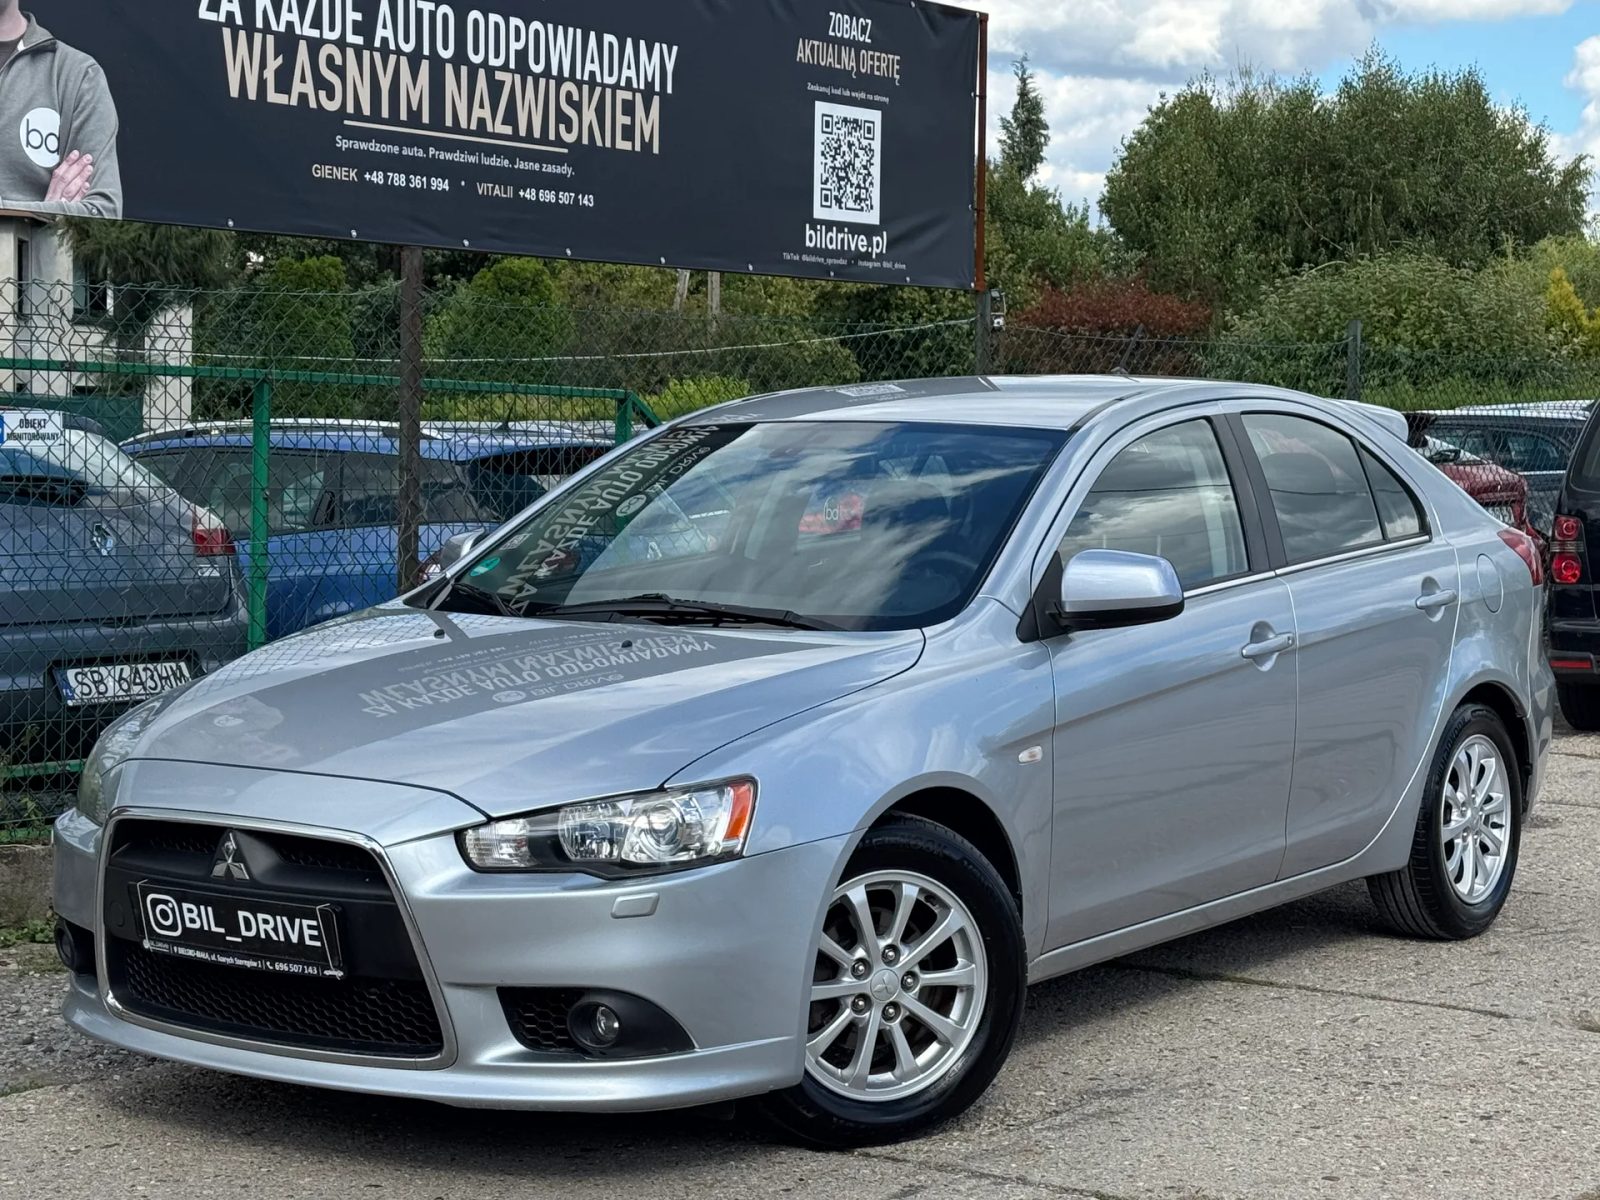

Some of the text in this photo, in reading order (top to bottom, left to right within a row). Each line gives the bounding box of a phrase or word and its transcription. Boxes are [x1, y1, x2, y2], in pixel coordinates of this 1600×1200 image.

[828, 11, 872, 43] ZOBACZ
[374, 0, 455, 59] AUTO
[467, 9, 678, 94] ODPOWIADAMY
[796, 38, 901, 85] AKTUALNĄ OFERTĘ
[222, 27, 660, 154] WŁASNYM NAZWISKIEM
[335, 135, 575, 178] Sprawdzone auta. Prawdziwi ludzie. Jasne zasady.
[312, 163, 449, 192] GIENEK +48 788 361 994
[476, 182, 594, 207] VITALII +48 696 507 143
[805, 223, 887, 259] bildrive.pl
[20, 418, 47, 429] OBIEKT
[74, 670, 108, 696] SB
[181, 902, 322, 947] BIL_DRIVE
[275, 962, 288, 971] 696
[289, 963, 303, 973] 507
[304, 965, 318, 974] 143
